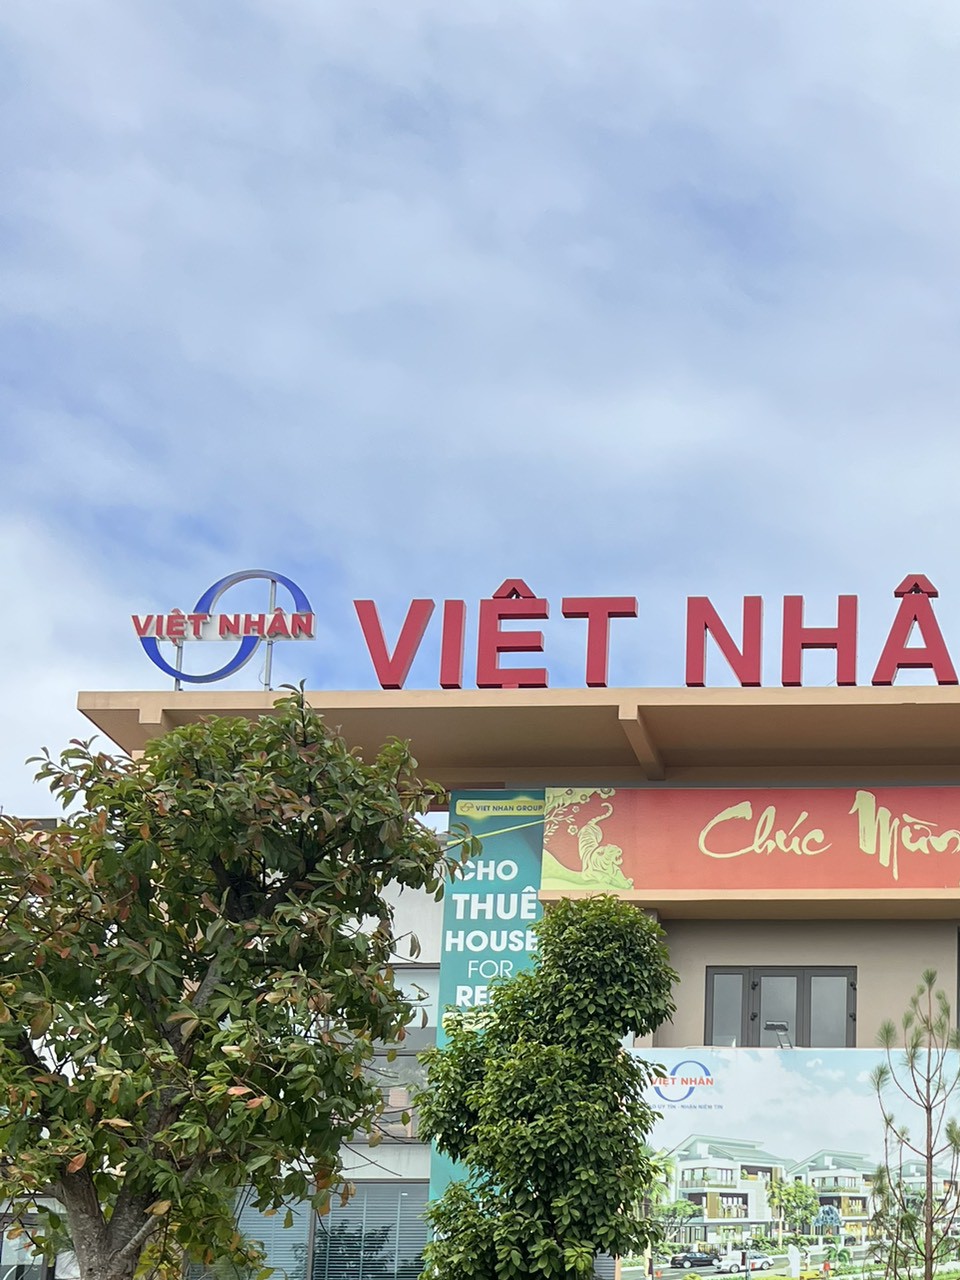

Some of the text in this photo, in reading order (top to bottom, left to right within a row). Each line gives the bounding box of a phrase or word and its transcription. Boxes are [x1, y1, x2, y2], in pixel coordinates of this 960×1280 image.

[218, 607, 314, 639] NHÂN
[516, 804, 543, 812] GROUP
[698, 801, 832, 859] Chúc
[455, 859, 519, 881] CHO
[451, 885, 538, 920] THUÊ
[444, 929, 538, 952] HOUSE
[467, 959, 514, 979] FOR
[680, 1075, 714, 1086] NHÂN
